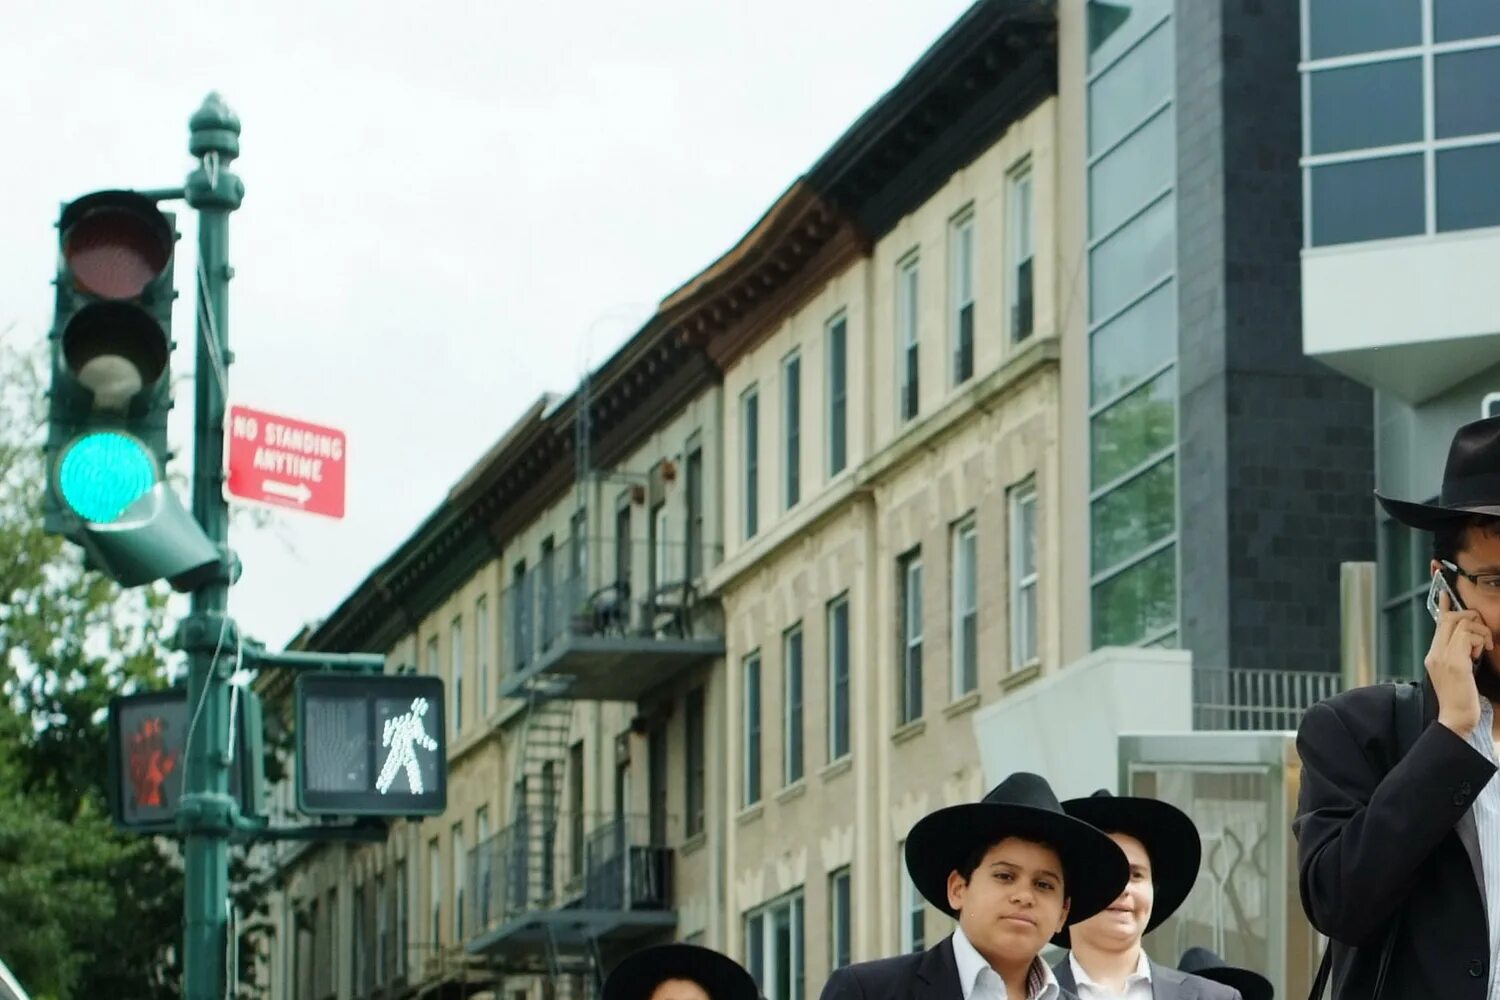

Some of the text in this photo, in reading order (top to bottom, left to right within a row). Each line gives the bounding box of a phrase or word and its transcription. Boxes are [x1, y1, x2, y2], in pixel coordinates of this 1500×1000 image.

[233, 415, 343, 462] NO STANDING
[253, 445, 323, 482] ANYTIME
